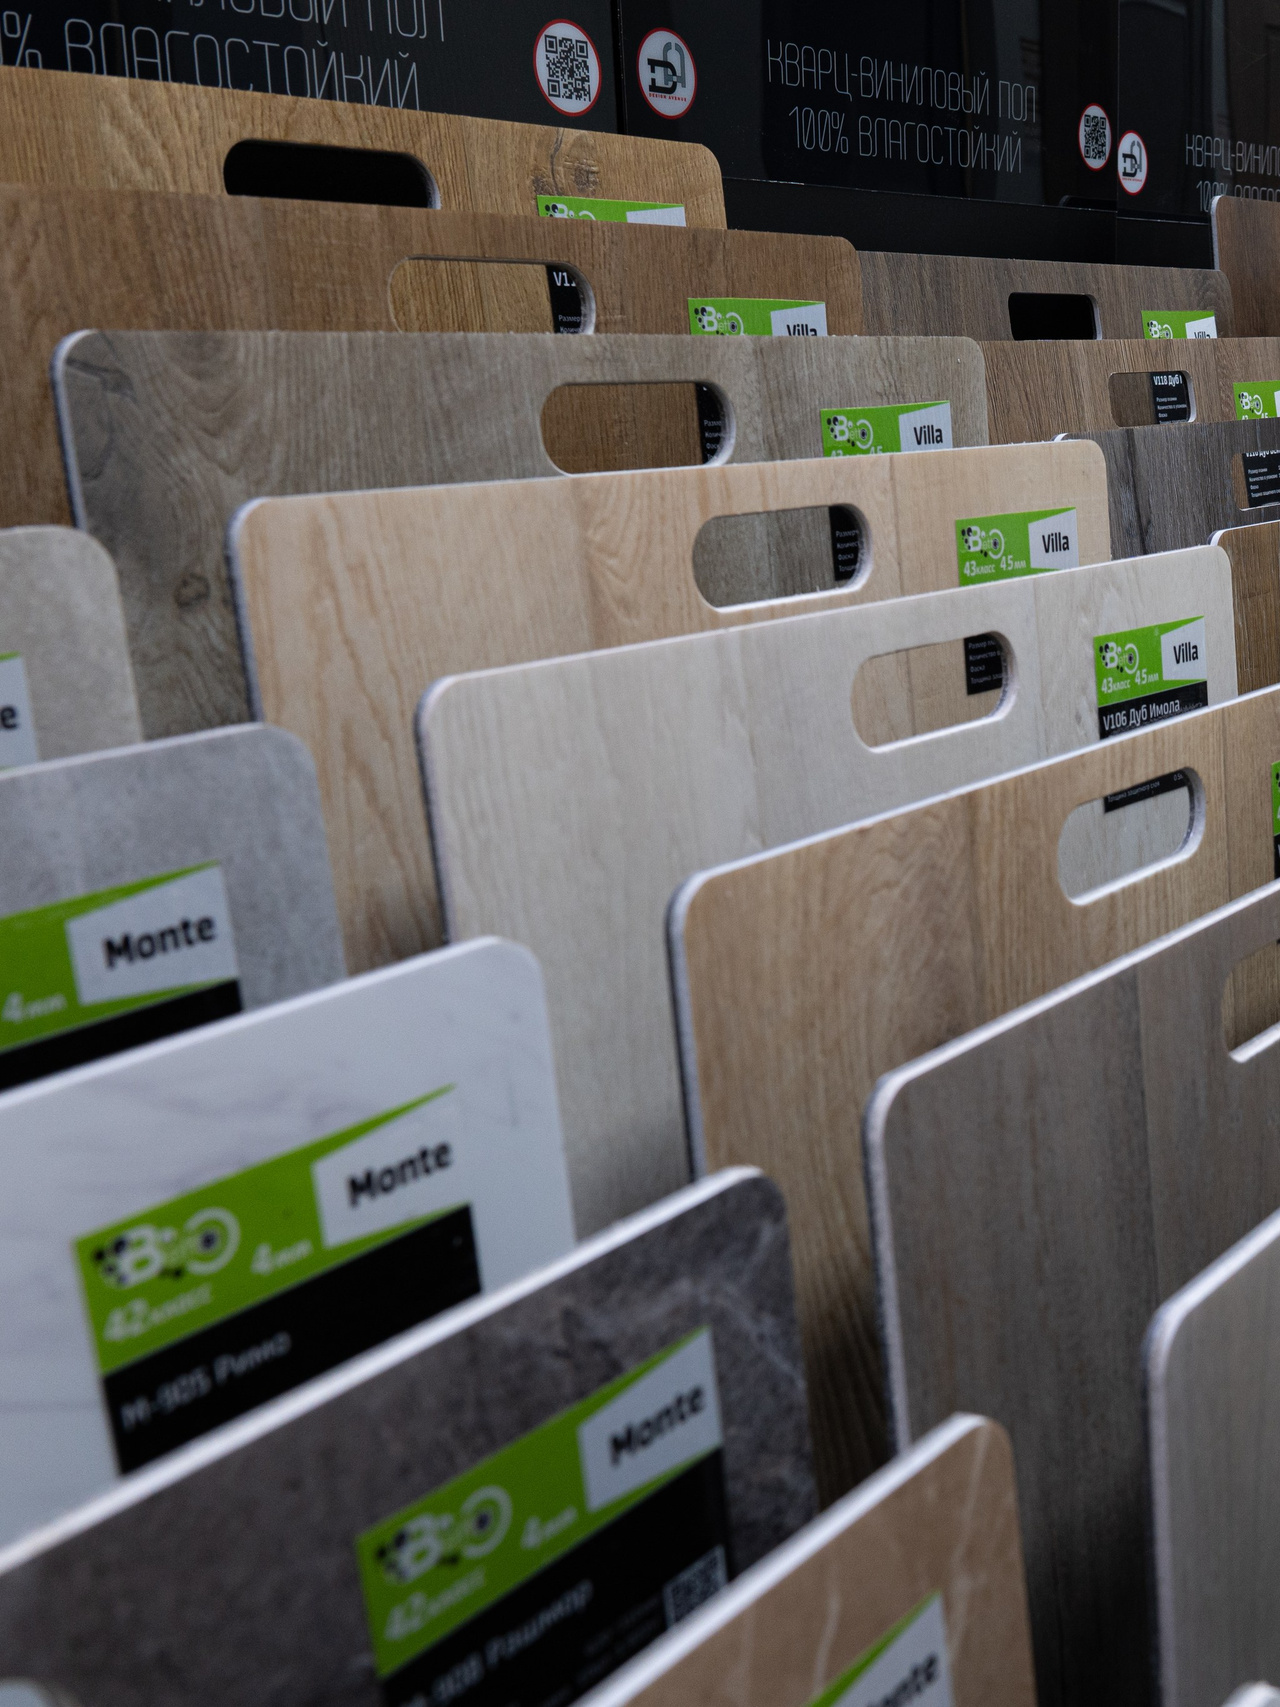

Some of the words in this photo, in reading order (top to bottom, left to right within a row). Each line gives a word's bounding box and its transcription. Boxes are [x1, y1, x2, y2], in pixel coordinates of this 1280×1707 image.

[64, 19, 421, 111] ВЛАГОСТОЙКИЙ
[766, 38, 990, 117] КВАРЦ-ВИНИЛОВЫЙ
[998, 79, 1037, 124] ПОЛ
[788, 104, 849, 155] 100%
[858, 115, 1022, 174] ВЛАГОСТОЙКИЙ
[1153, 375, 1168, 386] V118
[1168, 374, 1180, 387] Дуб
[913, 424, 944, 446] Villa
[1041, 531, 1070, 554] Villa
[1173, 641, 1200, 665] Villa
[1102, 708, 1128, 731] V106
[1128, 705, 1148, 727] Дуб
[1149, 699, 1181, 719] Имола
[103, 914, 218, 970] Monte
[344, 1139, 453, 1211] Monte
[607, 1384, 708, 1468] Monte
